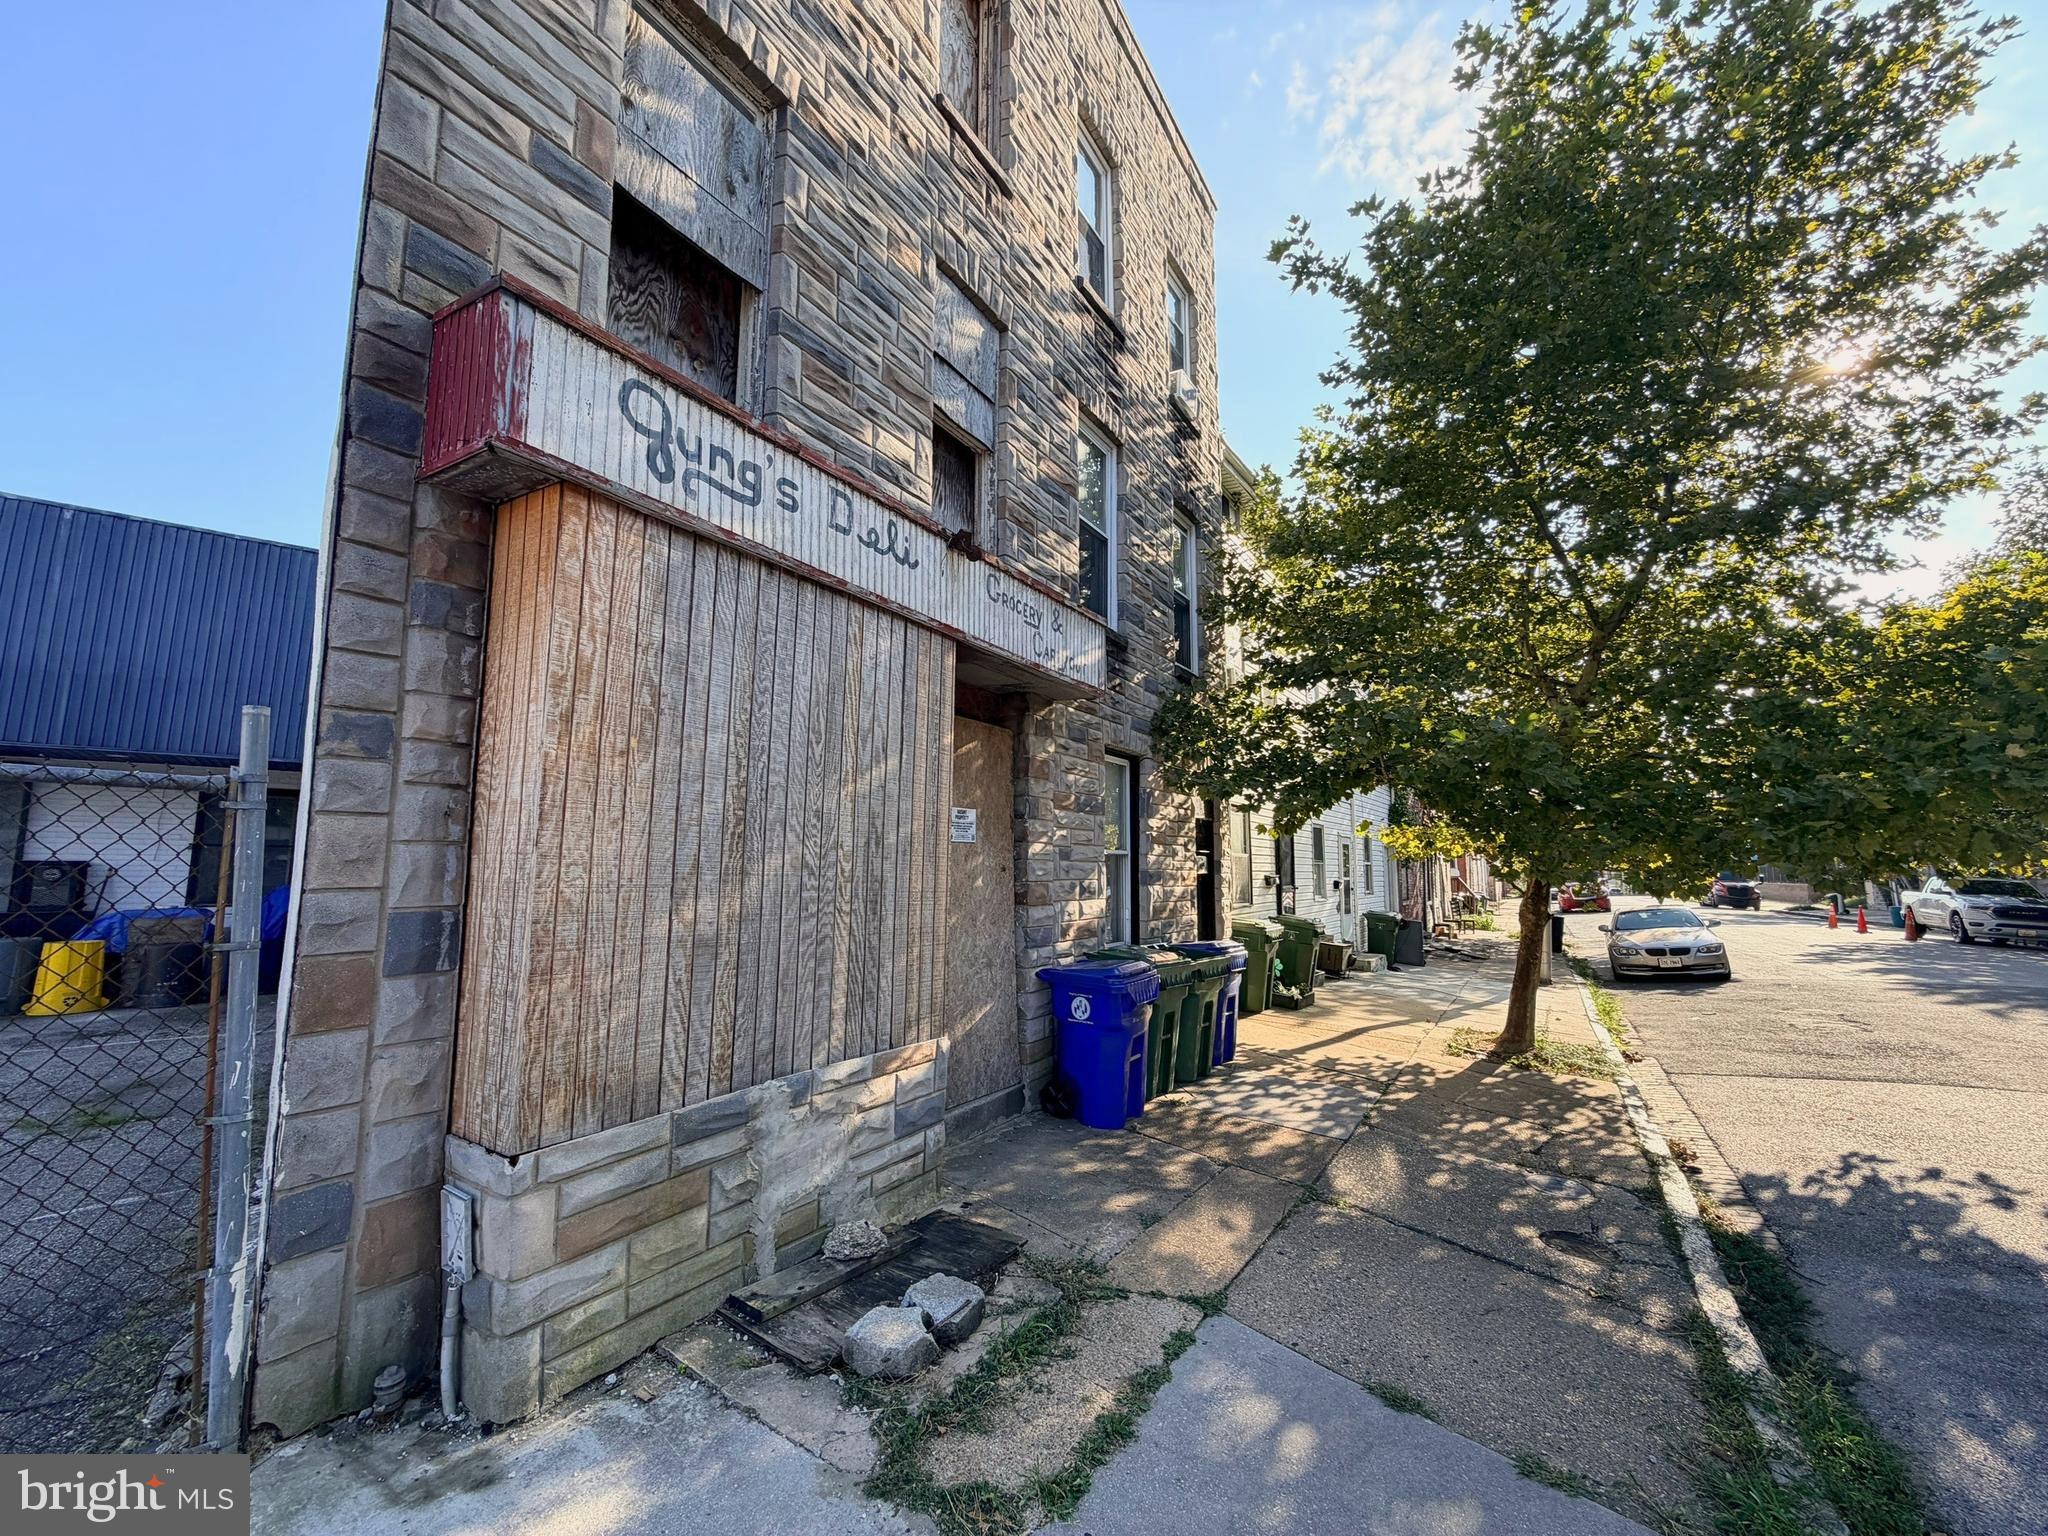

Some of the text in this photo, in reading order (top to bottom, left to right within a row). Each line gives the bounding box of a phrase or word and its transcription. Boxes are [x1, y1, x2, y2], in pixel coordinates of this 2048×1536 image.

[829, 486, 919, 570] Deli
[986, 573, 1063, 635] GROCERY &
